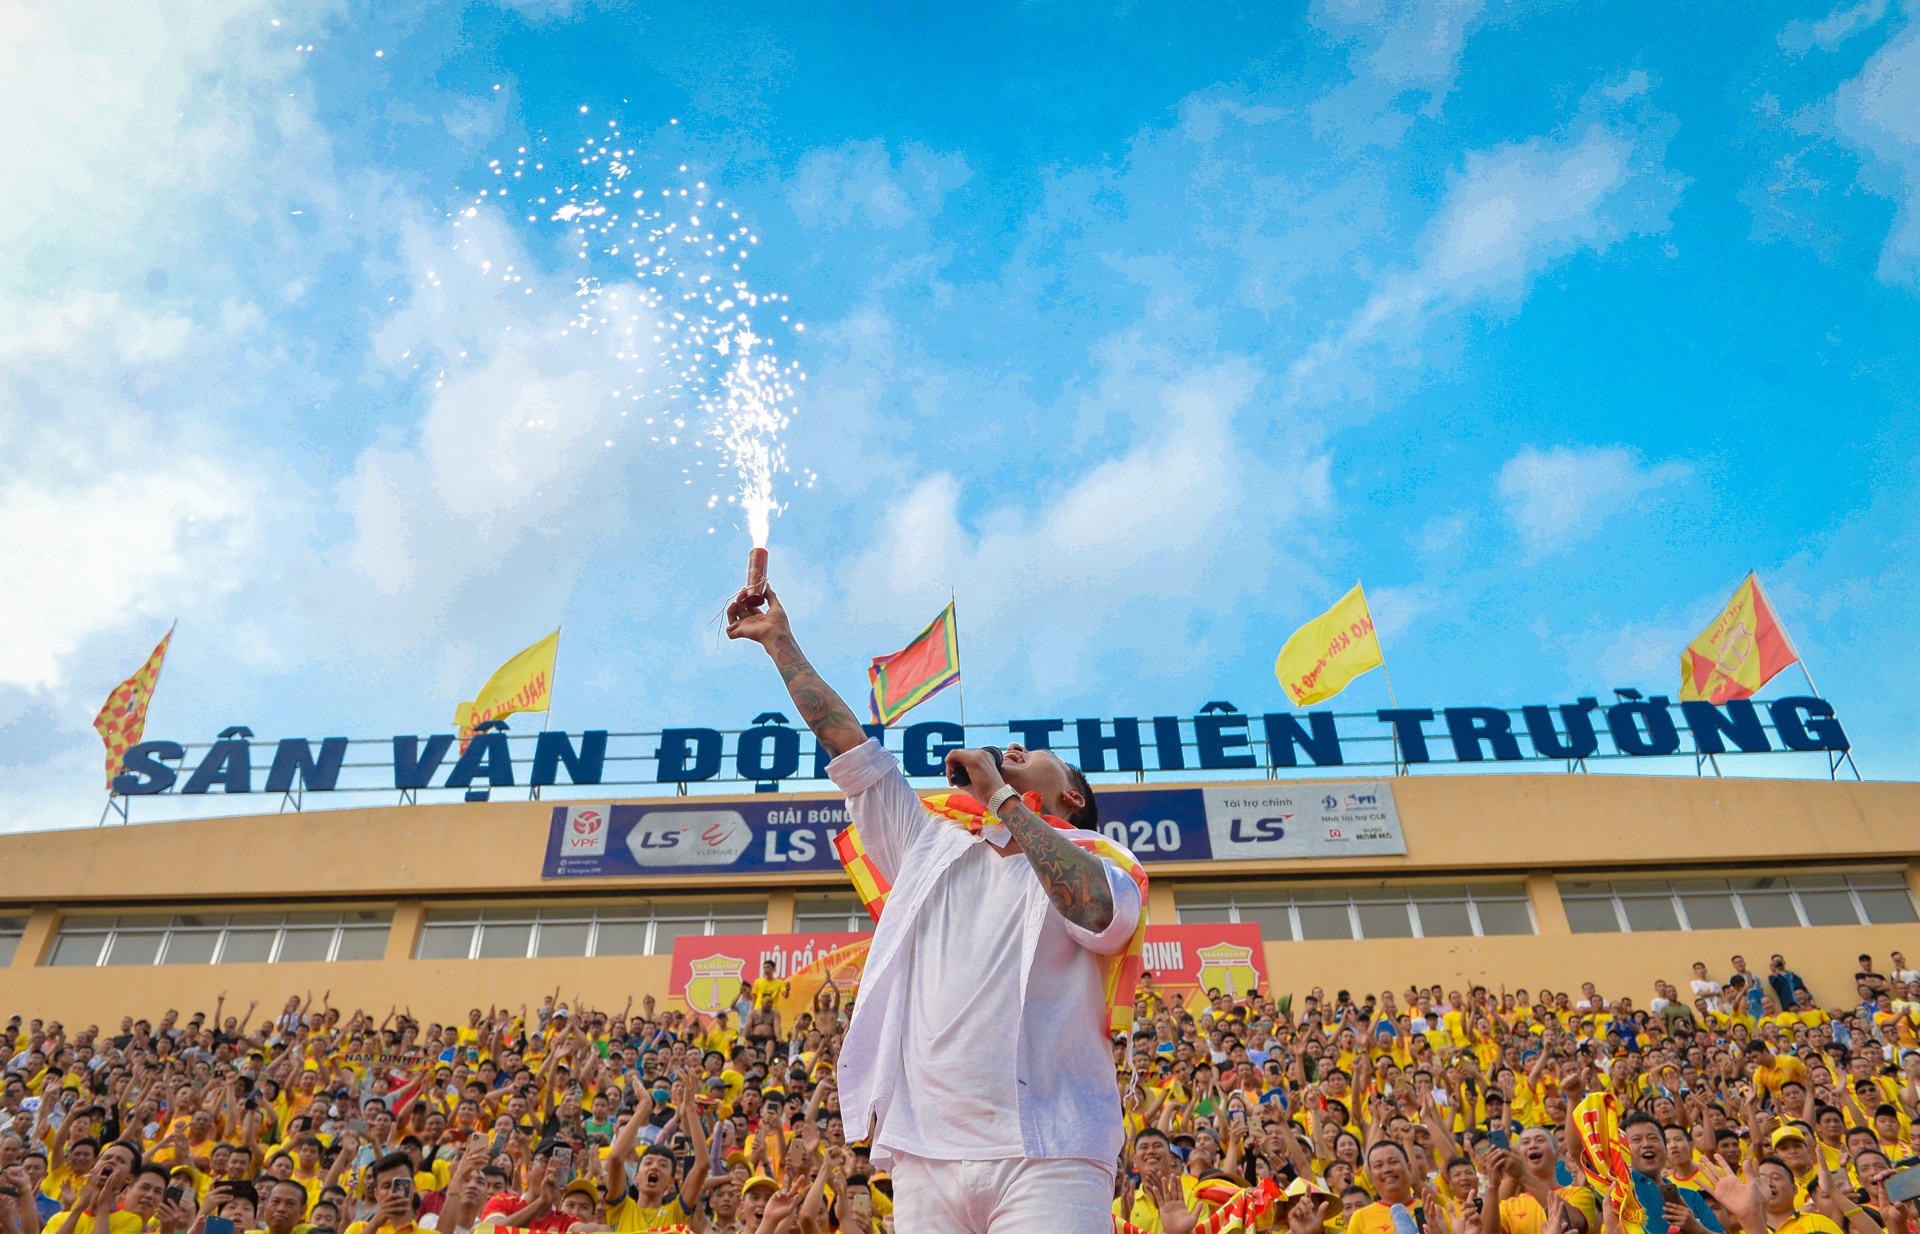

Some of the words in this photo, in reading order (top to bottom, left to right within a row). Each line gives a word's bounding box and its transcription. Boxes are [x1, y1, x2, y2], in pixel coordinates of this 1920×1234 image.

[112, 726, 348, 794] SÂN
[393, 719, 608, 802] VẬN
[1008, 701, 1344, 773] THIÊN
[1376, 688, 1850, 763] TRƯỜNG
[1224, 799, 1241, 808] Tài
[1242, 799, 1259, 809] trợ
[1262, 797, 1293, 807] chính
[767, 807, 802, 825] GIẢI
[808, 807, 854, 824] BÓNG
[640, 830, 682, 850] LS
[1102, 819, 1182, 853] 020
[1230, 817, 1285, 843] LS
[570, 838, 600, 848] VPF
[764, 828, 817, 863] LS
[1142, 942, 1184, 977] ĐỊNH
[345, 1053, 374, 1062] NAM
